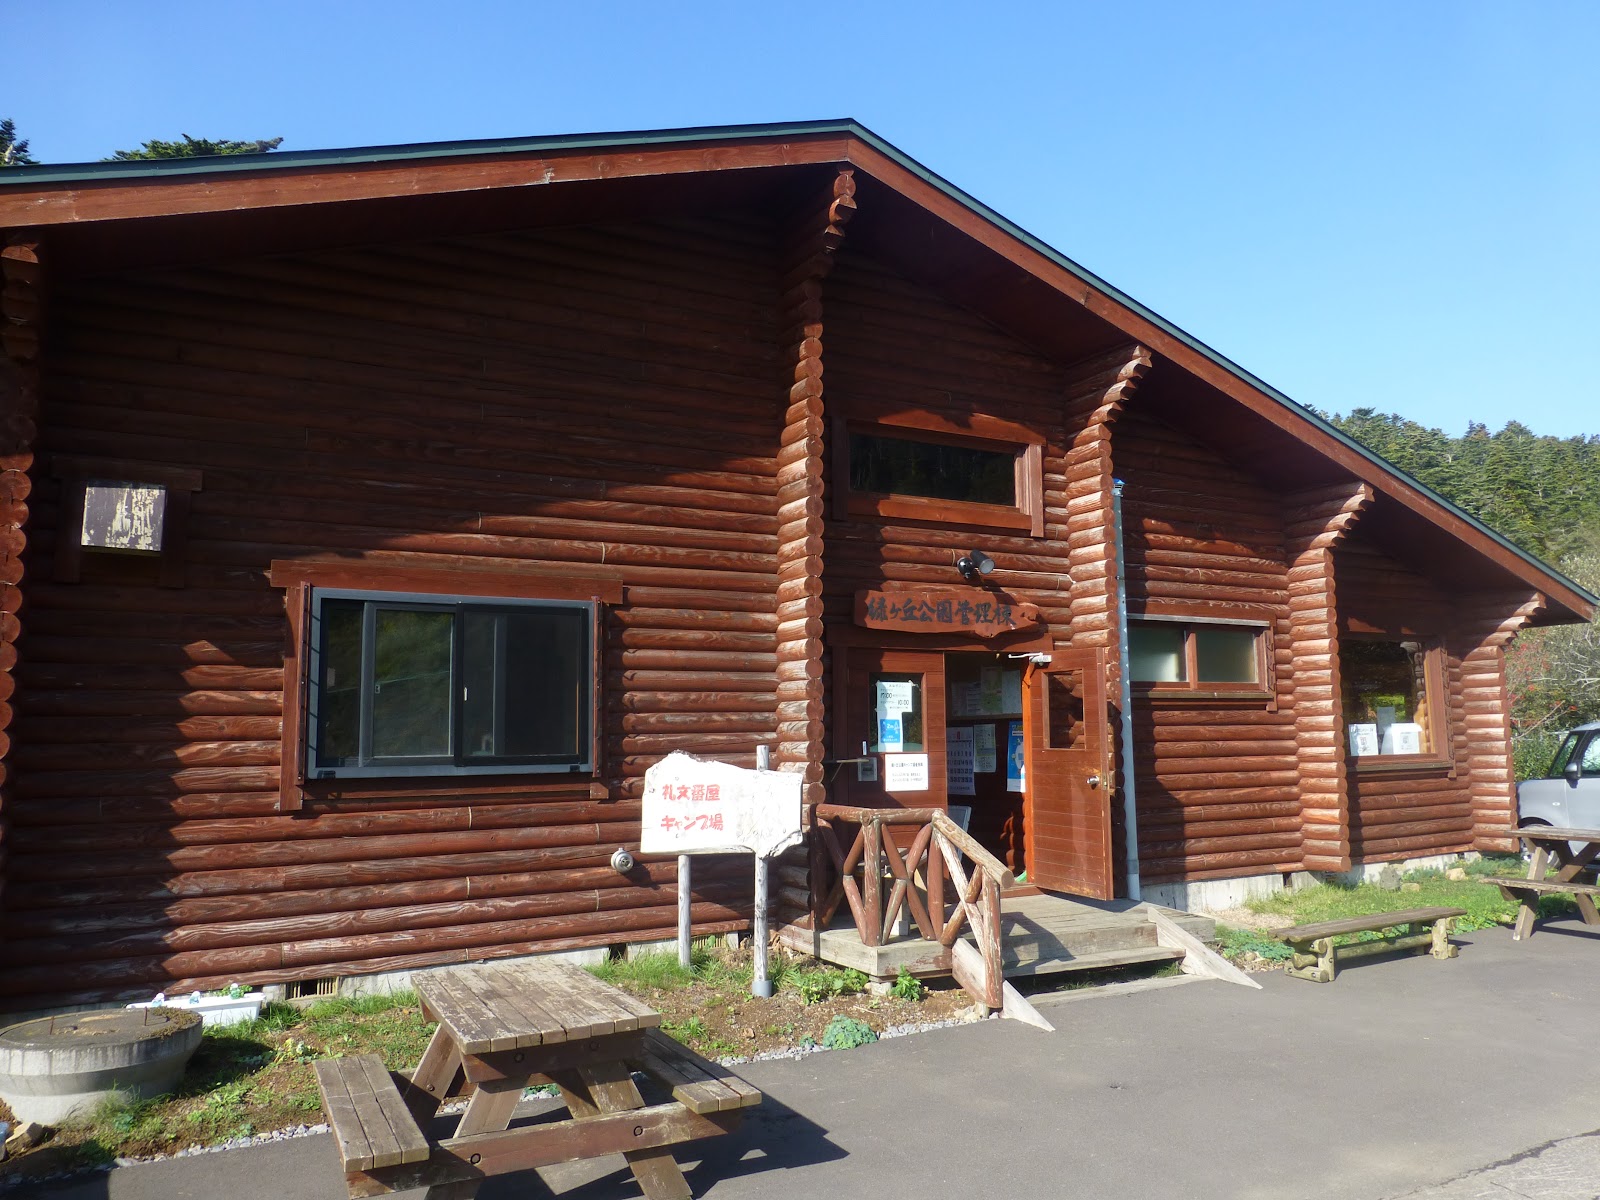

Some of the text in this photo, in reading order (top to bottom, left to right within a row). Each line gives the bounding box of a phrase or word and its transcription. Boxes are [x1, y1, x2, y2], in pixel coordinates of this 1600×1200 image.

[662, 784, 721, 802] 礼文番屋
[660, 813, 724, 832] キャンプ場
